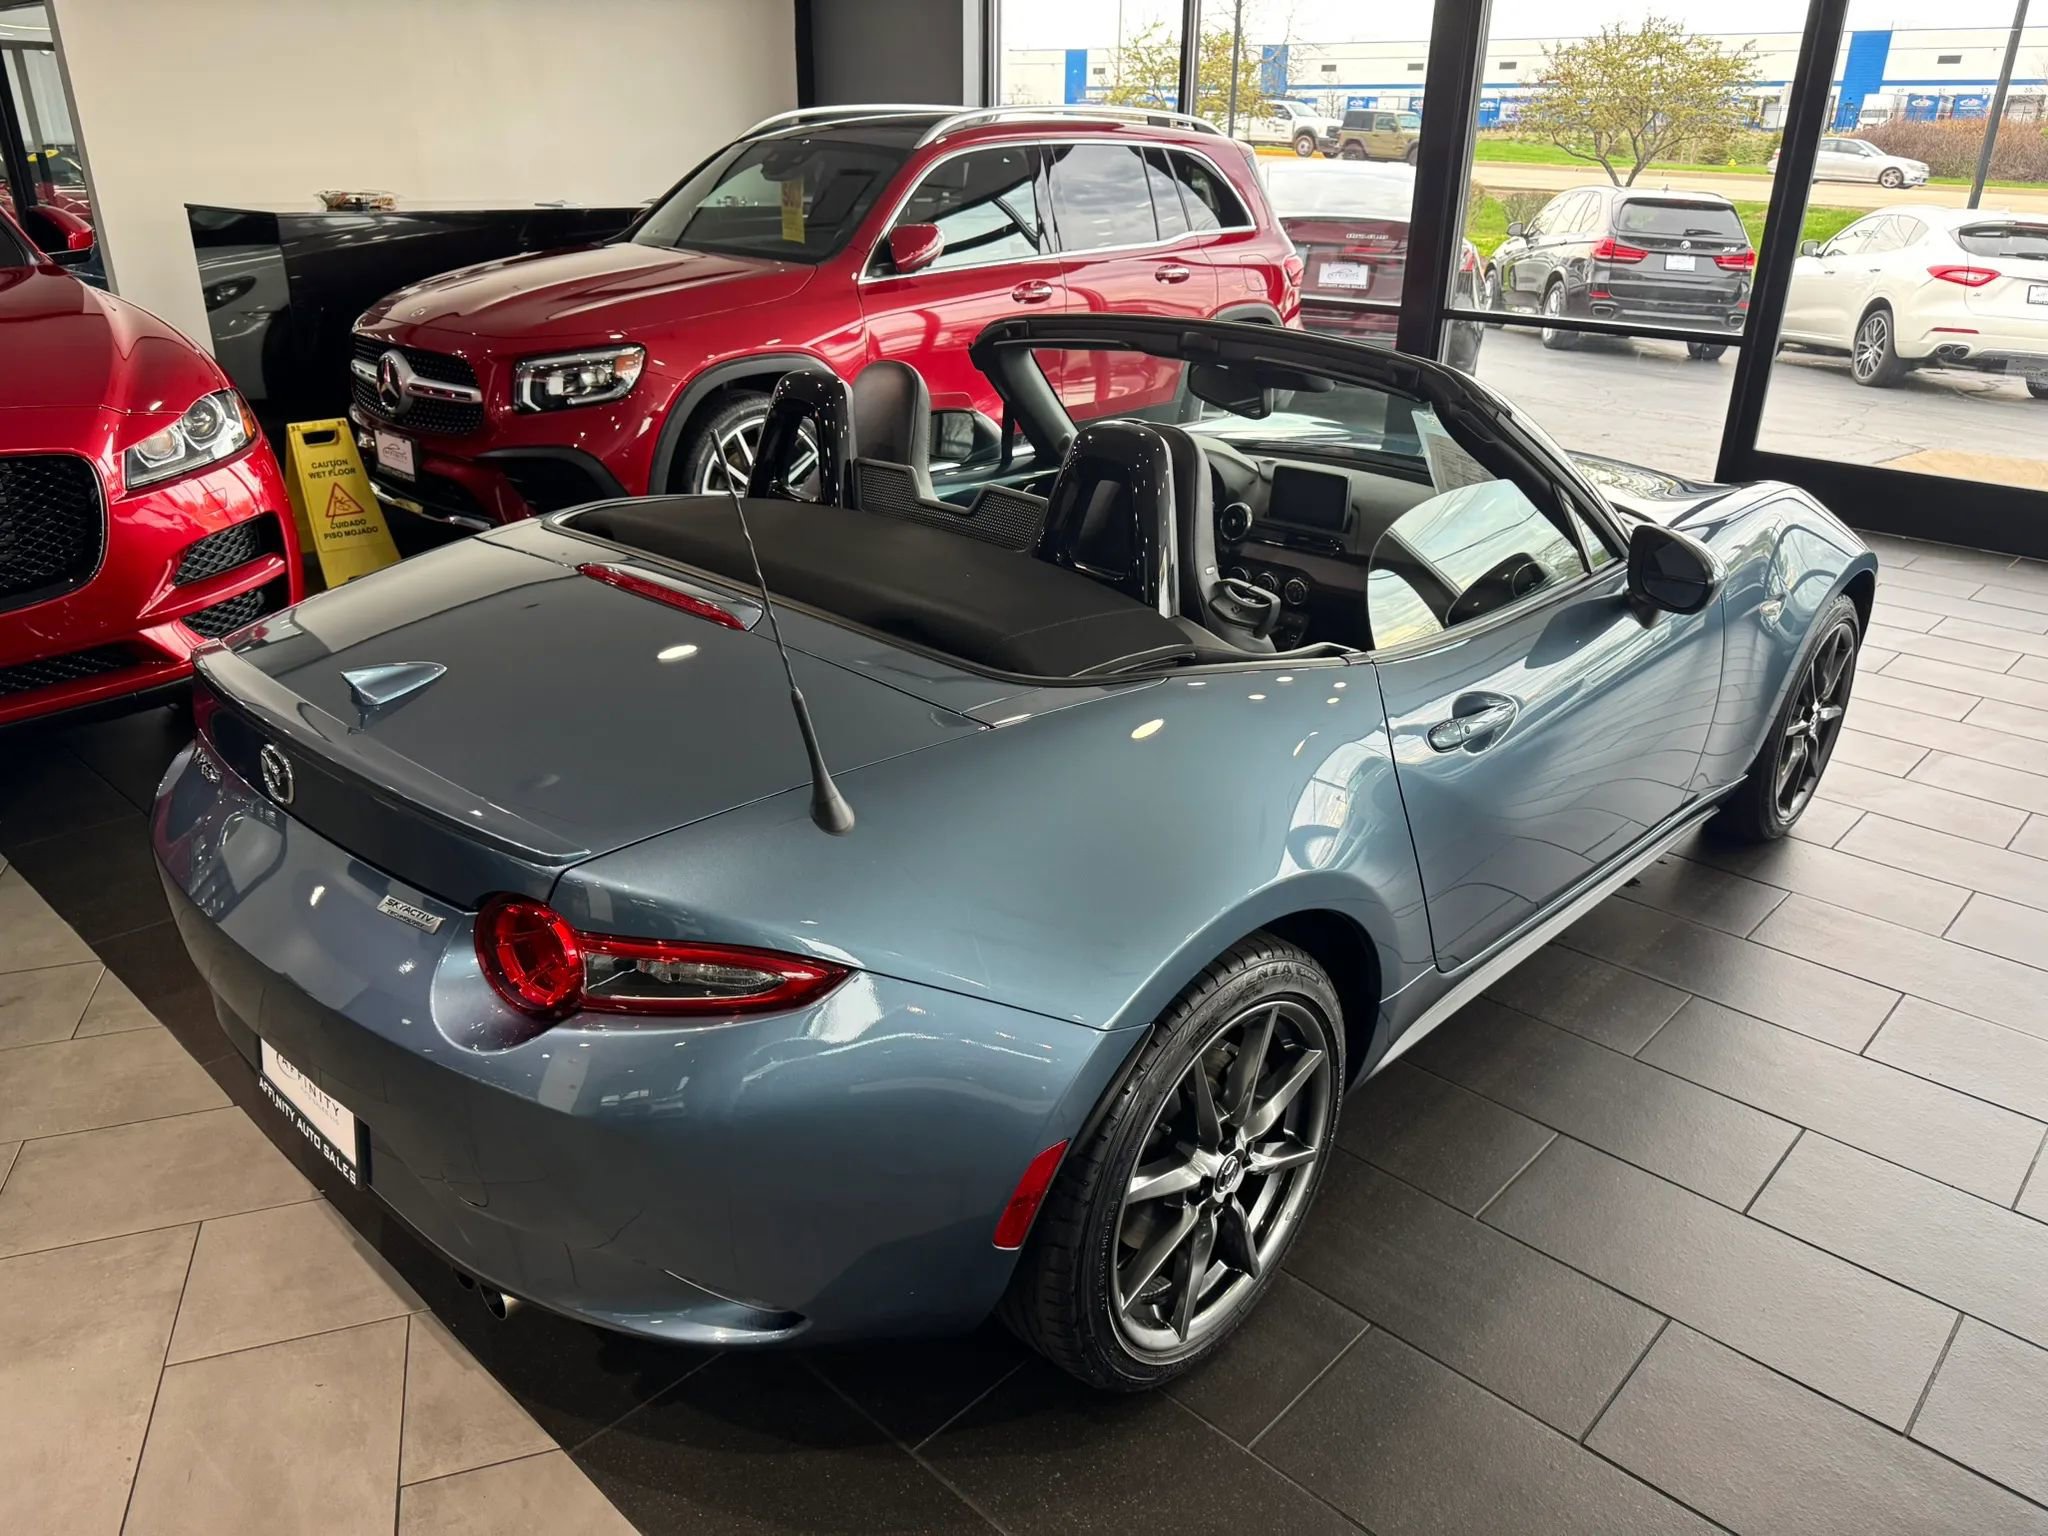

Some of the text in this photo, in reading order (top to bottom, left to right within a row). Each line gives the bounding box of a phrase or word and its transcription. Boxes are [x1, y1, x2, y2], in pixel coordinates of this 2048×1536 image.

[311, 458, 348, 470] CAUTION
[308, 467, 357, 479] WET FLOOR
[330, 518, 367, 530] CUIDADO
[324, 526, 378, 540] PISO MOJADO
[385, 898, 434, 922] SKYACTIV
[258, 1076, 296, 1123] AFFINITY
[296, 1118, 321, 1150] AUTO
[323, 1144, 357, 1186] SALES
